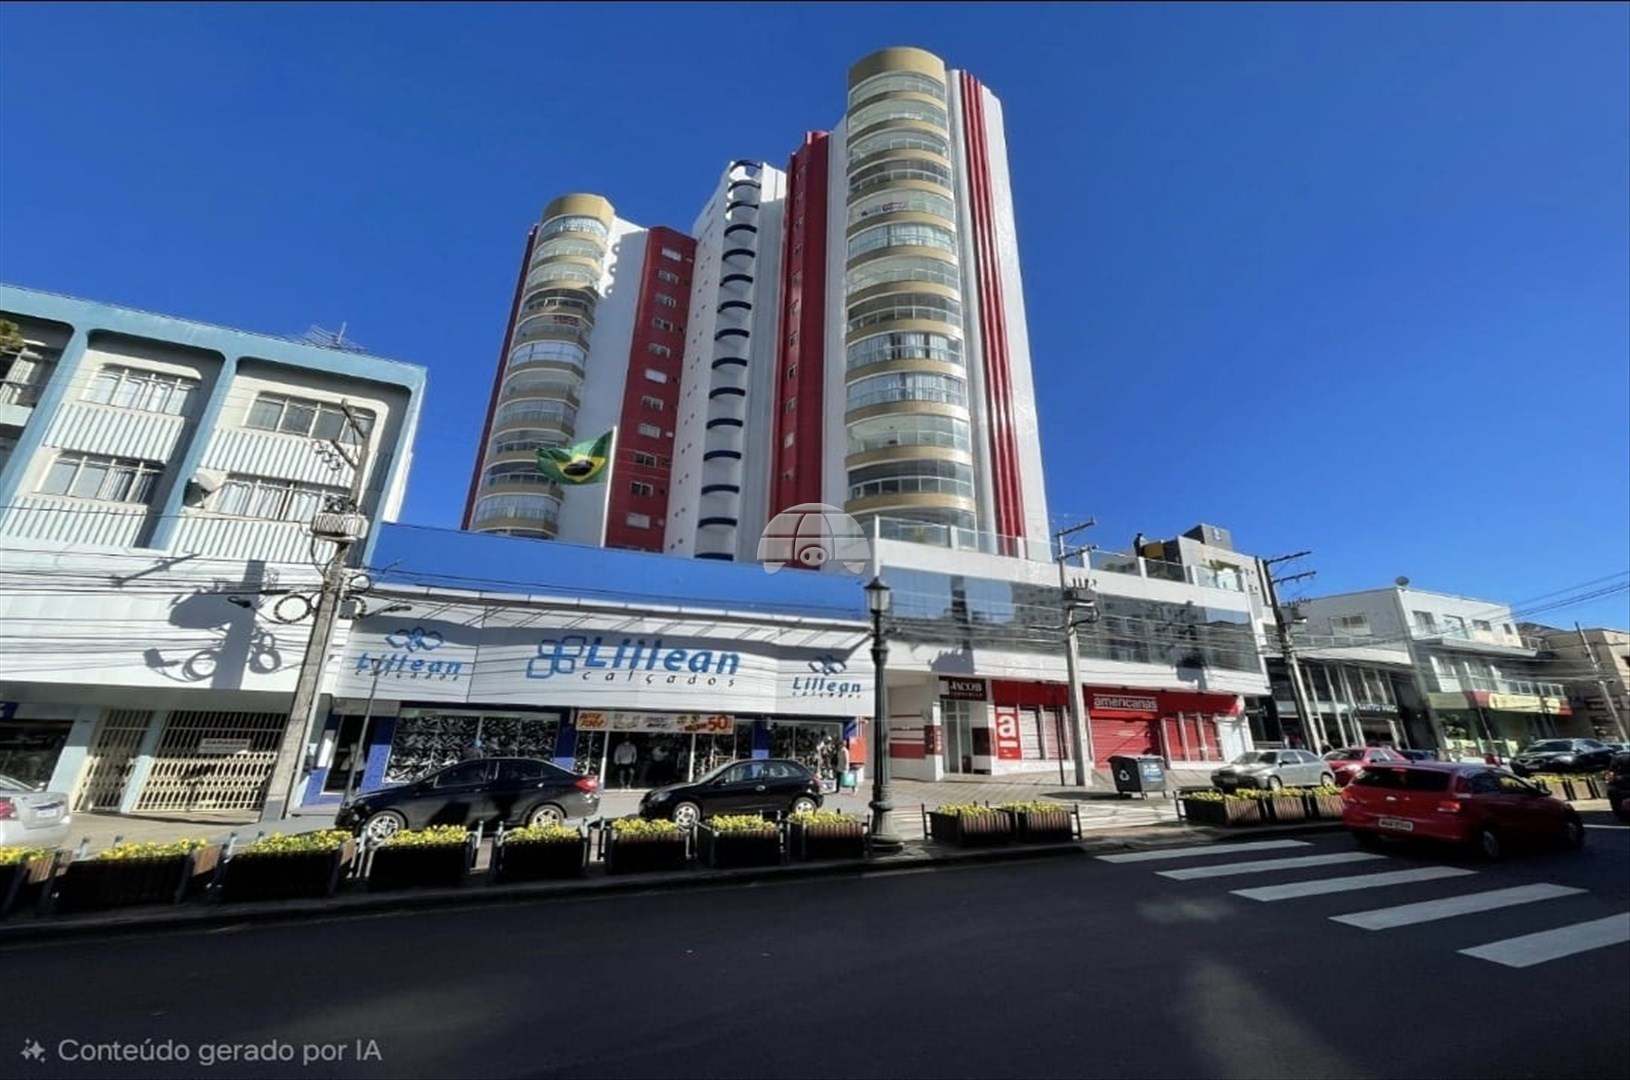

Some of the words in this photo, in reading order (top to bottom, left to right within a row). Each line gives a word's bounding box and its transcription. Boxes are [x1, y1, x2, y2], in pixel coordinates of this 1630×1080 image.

[355, 652, 461, 674] Lillean
[585, 637, 740, 674] Lillean
[582, 671, 735, 687] calçados
[792, 677, 861, 693] Lillean
[950, 681, 982, 691] JACOB
[1094, 698, 1157, 710] americanas
[998, 715, 1017, 738] a
